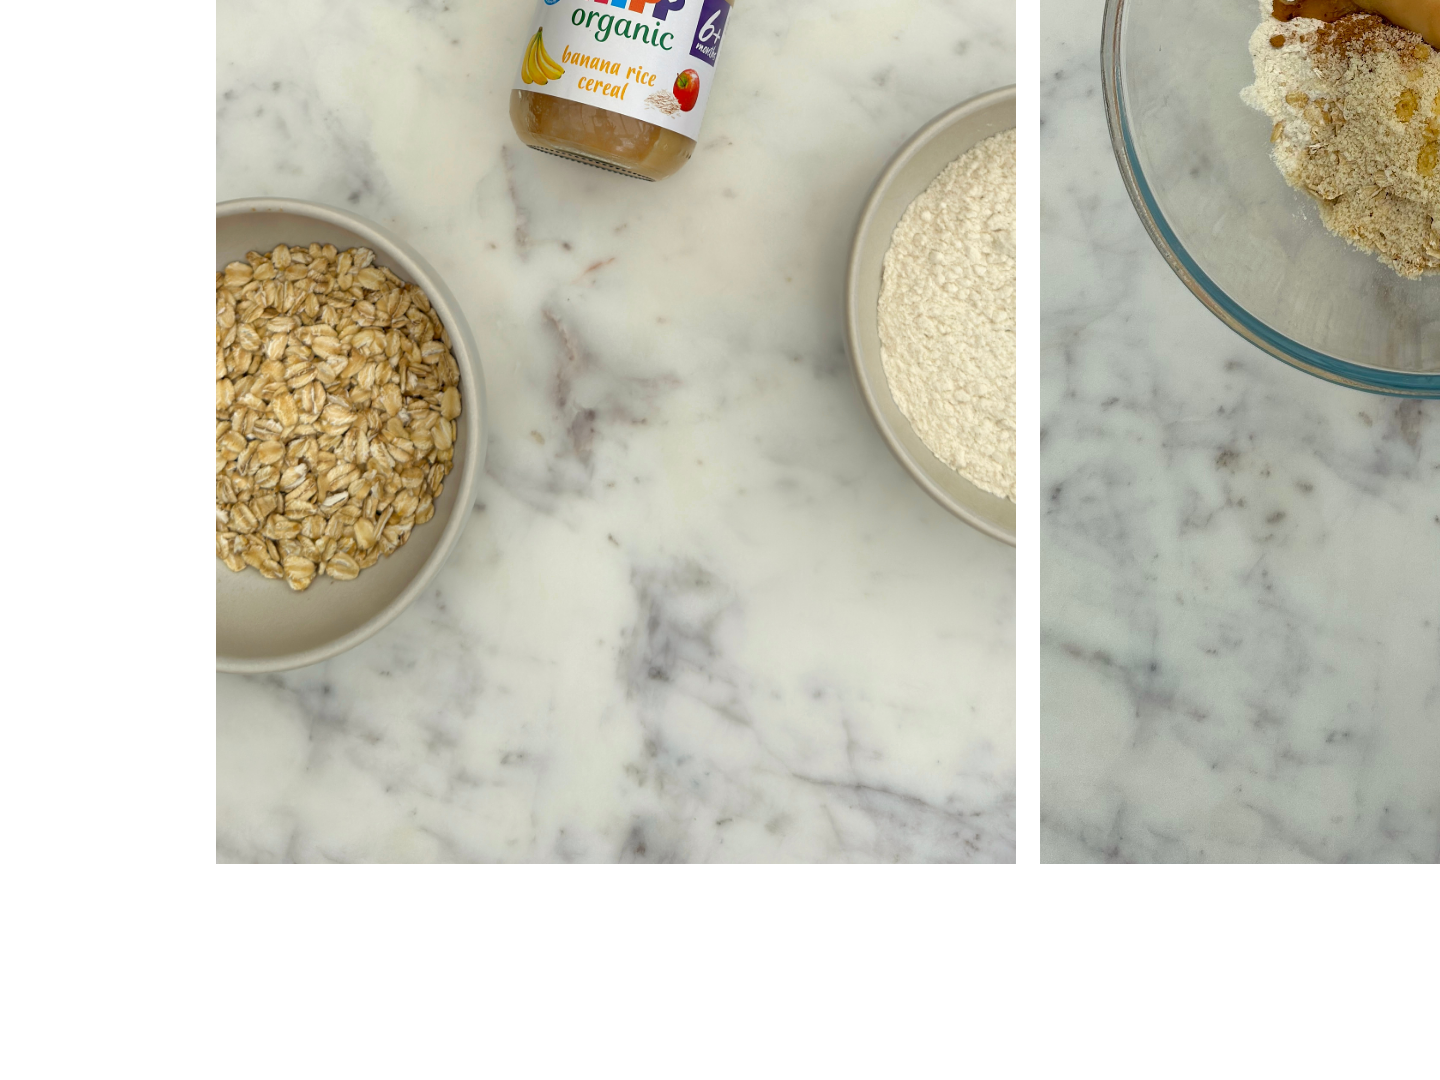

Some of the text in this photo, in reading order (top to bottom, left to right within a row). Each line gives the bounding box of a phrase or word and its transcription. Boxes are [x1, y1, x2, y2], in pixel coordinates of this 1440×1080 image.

[571, 8, 674, 51] organic
[698, 9, 721, 44] 6+
[561, 44, 657, 88] banana rice
[577, 74, 629, 101] cereal
